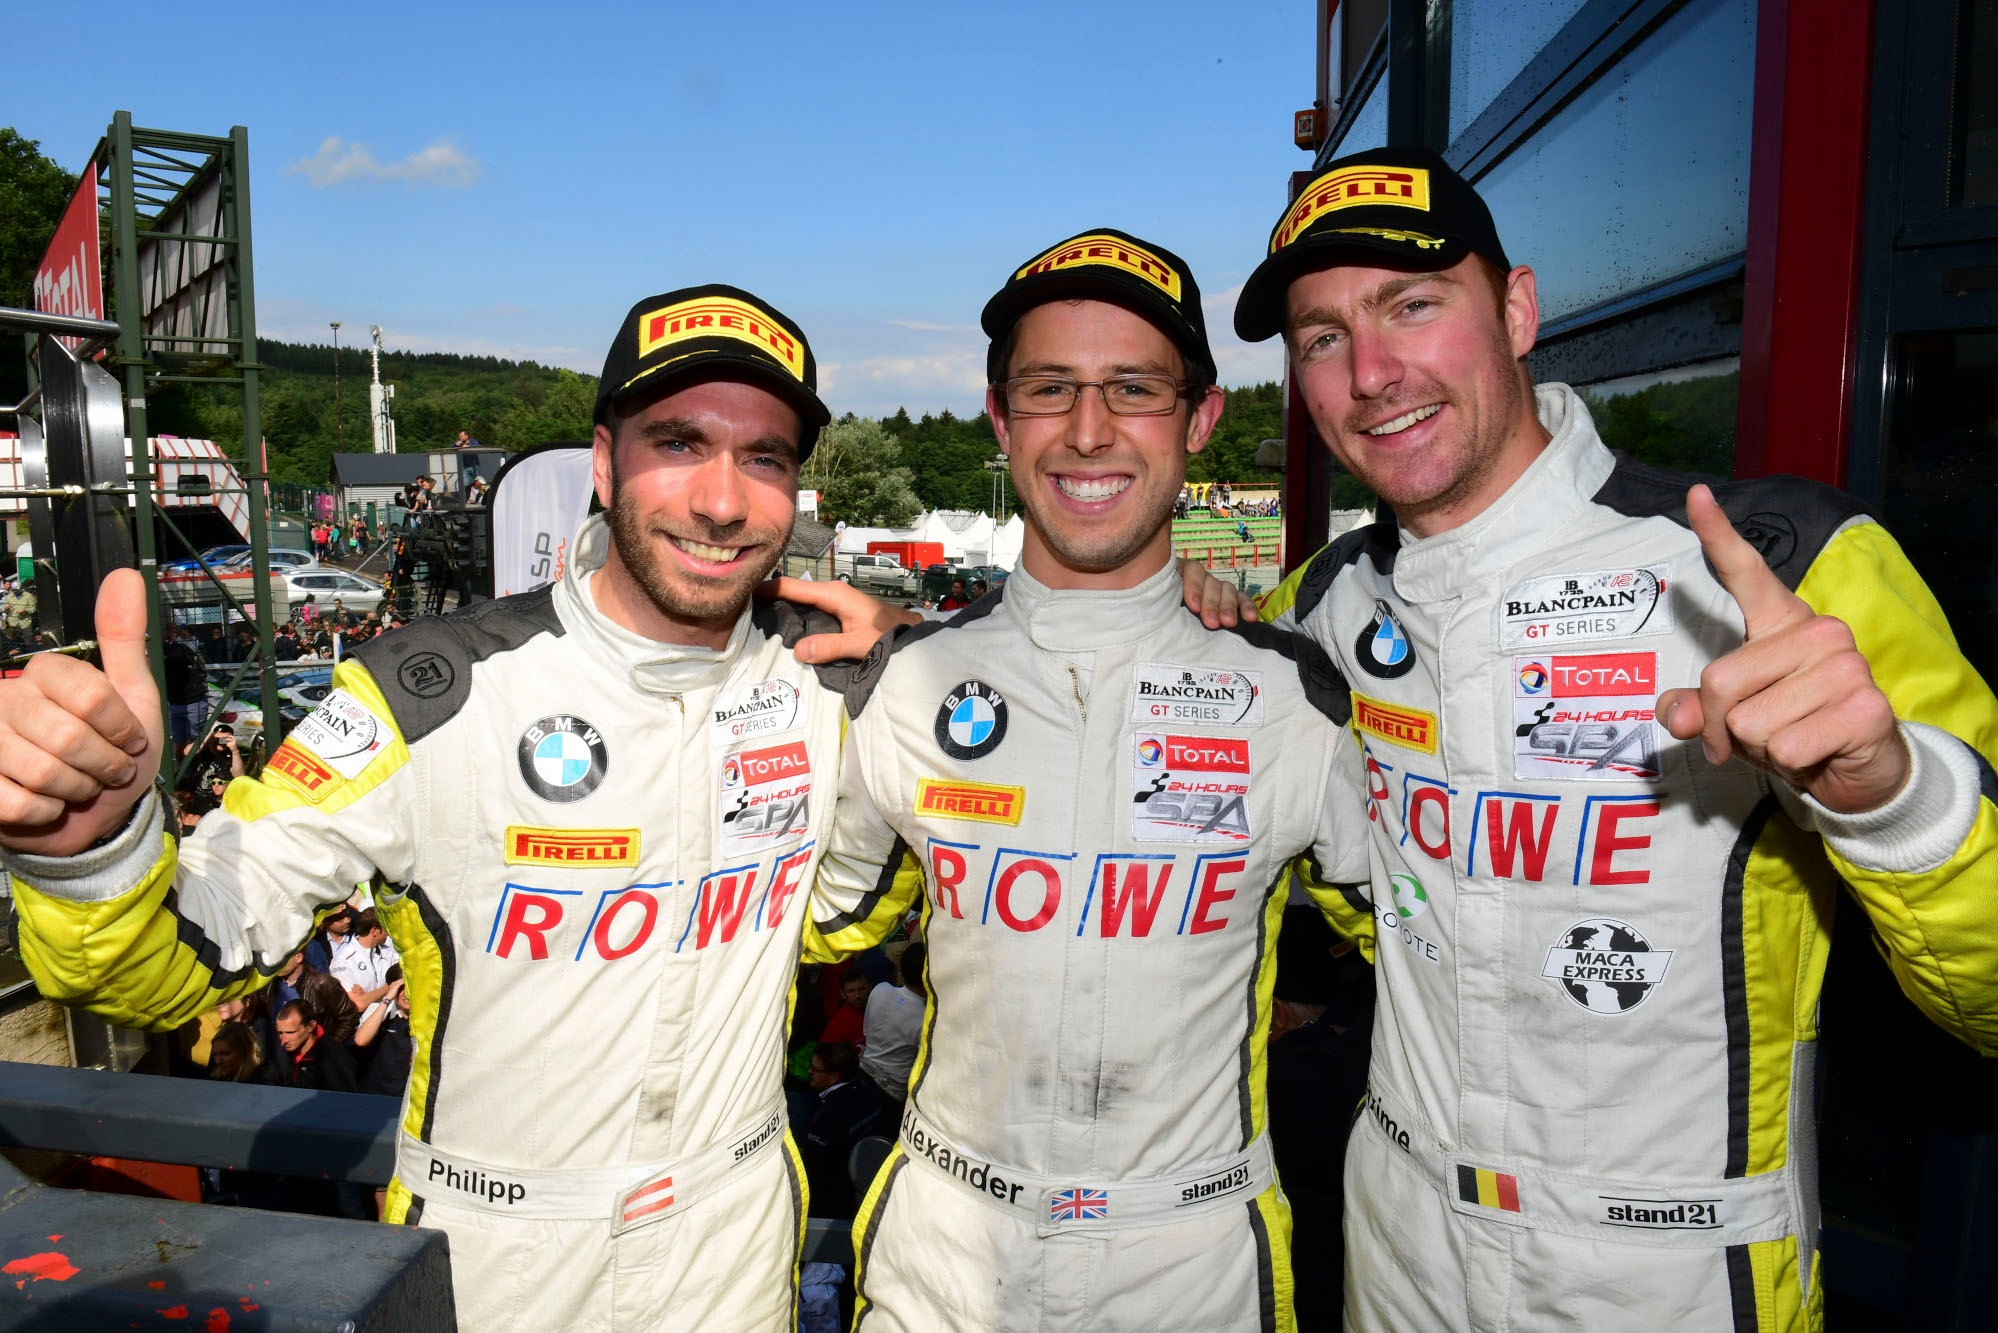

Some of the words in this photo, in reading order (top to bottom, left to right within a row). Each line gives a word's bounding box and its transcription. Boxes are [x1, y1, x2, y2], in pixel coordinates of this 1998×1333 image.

[1275, 172, 1413, 251] PIRELLI
[1026, 239, 1170, 287] PIRELLI
[649, 304, 794, 364] PIRELLI
[1506, 590, 1636, 617] BLANCPAIN
[1526, 624, 1549, 638] GT
[1556, 618, 1616, 636] SERIES
[409, 661, 444, 687] 21
[1554, 666, 1649, 687] TOTAL
[1139, 682, 1235, 700] BLANCPAIN
[1150, 705, 1169, 716] GT
[1175, 706, 1220, 719] SERIES
[1357, 700, 1428, 745] PIRELLI
[1552, 711, 1582, 723] 24
[1583, 709, 1655, 723] HOURS
[732, 724, 745, 735] GT
[1169, 745, 1245, 764] TOTAL
[1529, 723, 1659, 772] SPA
[743, 753, 806, 776] TOTAL
[750, 796, 769, 807] 24
[771, 784, 811, 801] HOURS
[923, 786, 1014, 817] PIRELLI
[1167, 782, 1192, 792] 24
[1196, 783, 1247, 795] HOURS
[734, 793, 809, 839] SPA
[1146, 792, 1250, 834] SPA
[516, 834, 629, 861] PIRELLI
[933, 846, 1246, 938] ROWE
[1563, 965, 1645, 981] EXPRESS
[1575, 952, 1635, 967] MACA
[734, 1112, 780, 1161] stand21
[903, 1109, 1024, 1204] Alexander
[429, 1159, 526, 1204] Philipp
[1181, 1166, 1250, 1201] stand21
[1608, 1204, 1716, 1225] stand21
